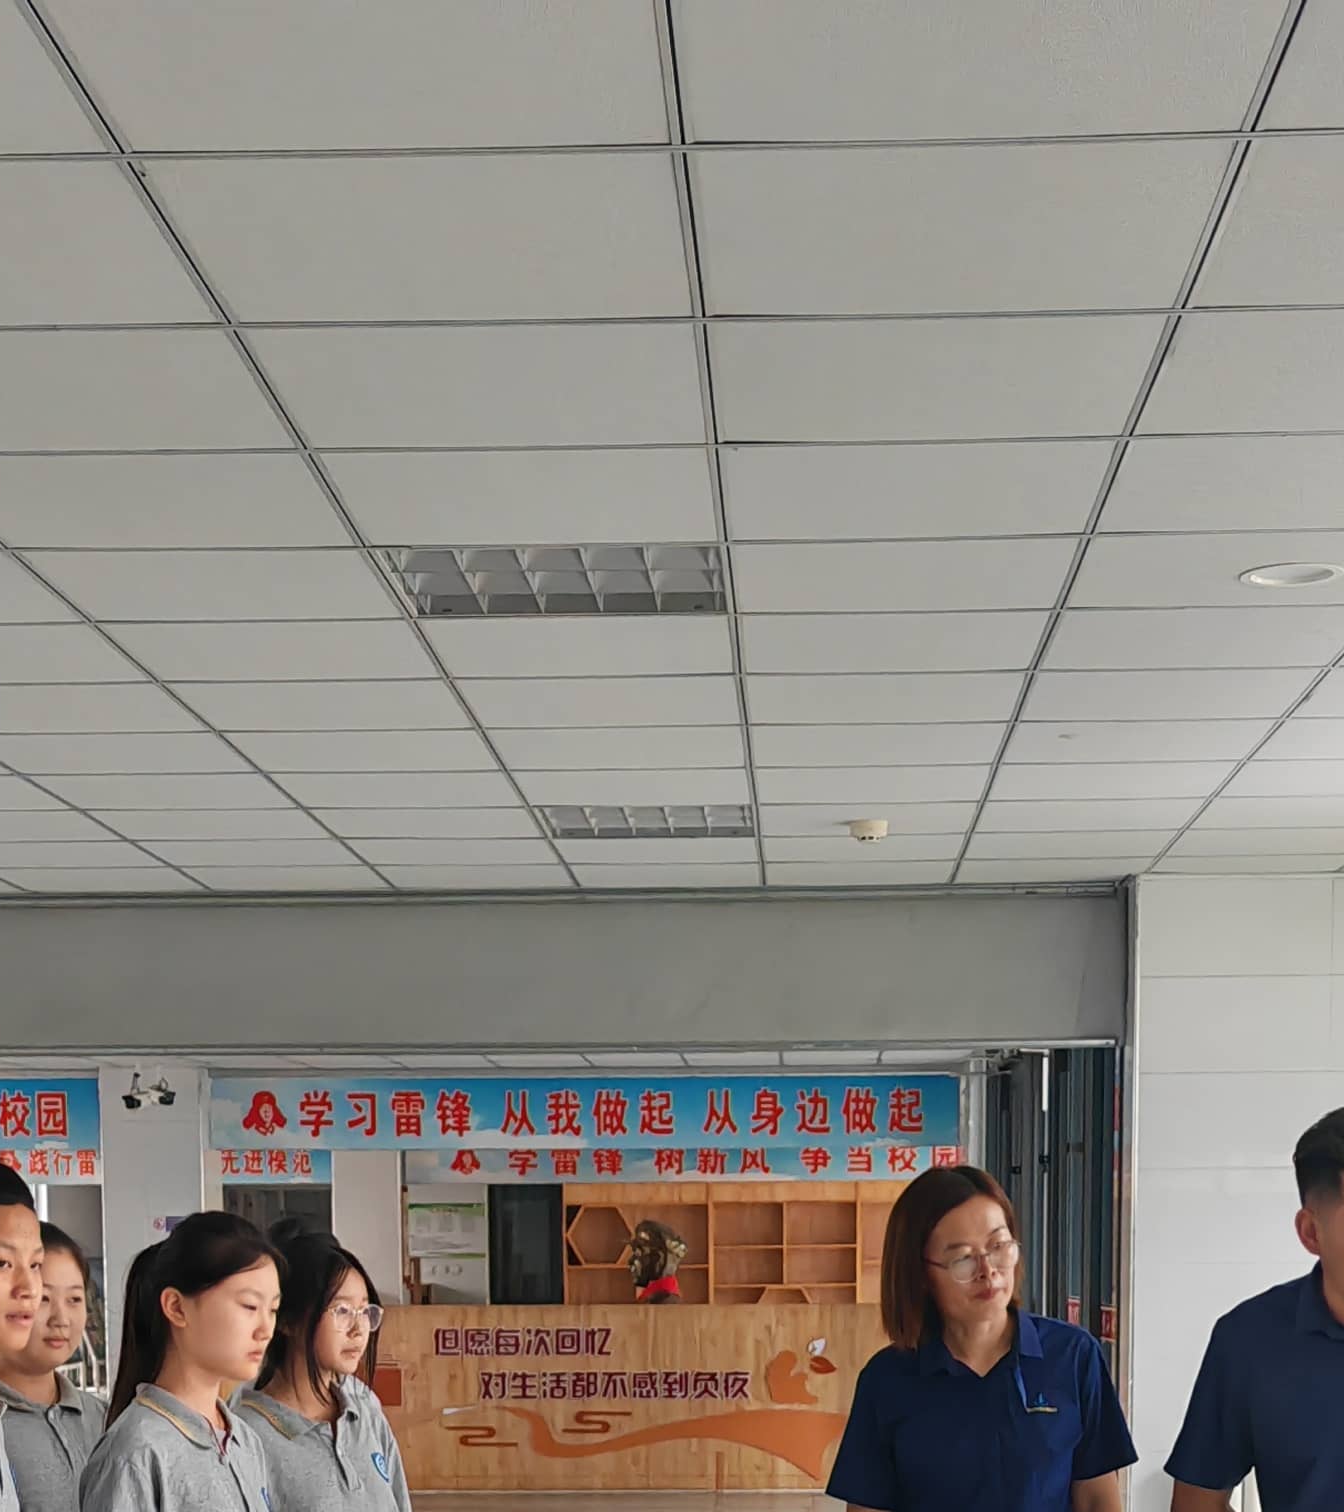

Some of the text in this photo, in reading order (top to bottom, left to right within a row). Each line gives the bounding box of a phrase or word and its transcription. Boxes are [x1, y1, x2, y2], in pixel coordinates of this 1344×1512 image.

[298, 1087, 925, 1139] 学习雷锋 从我做起 从身边做起
[507, 1148, 624, 1177] 学雷锋
[653, 1147, 771, 1177] 树新风
[433, 1327, 612, 1357] 但愿每次回忆
[479, 1369, 753, 1401] 对生活都不感到负疚
